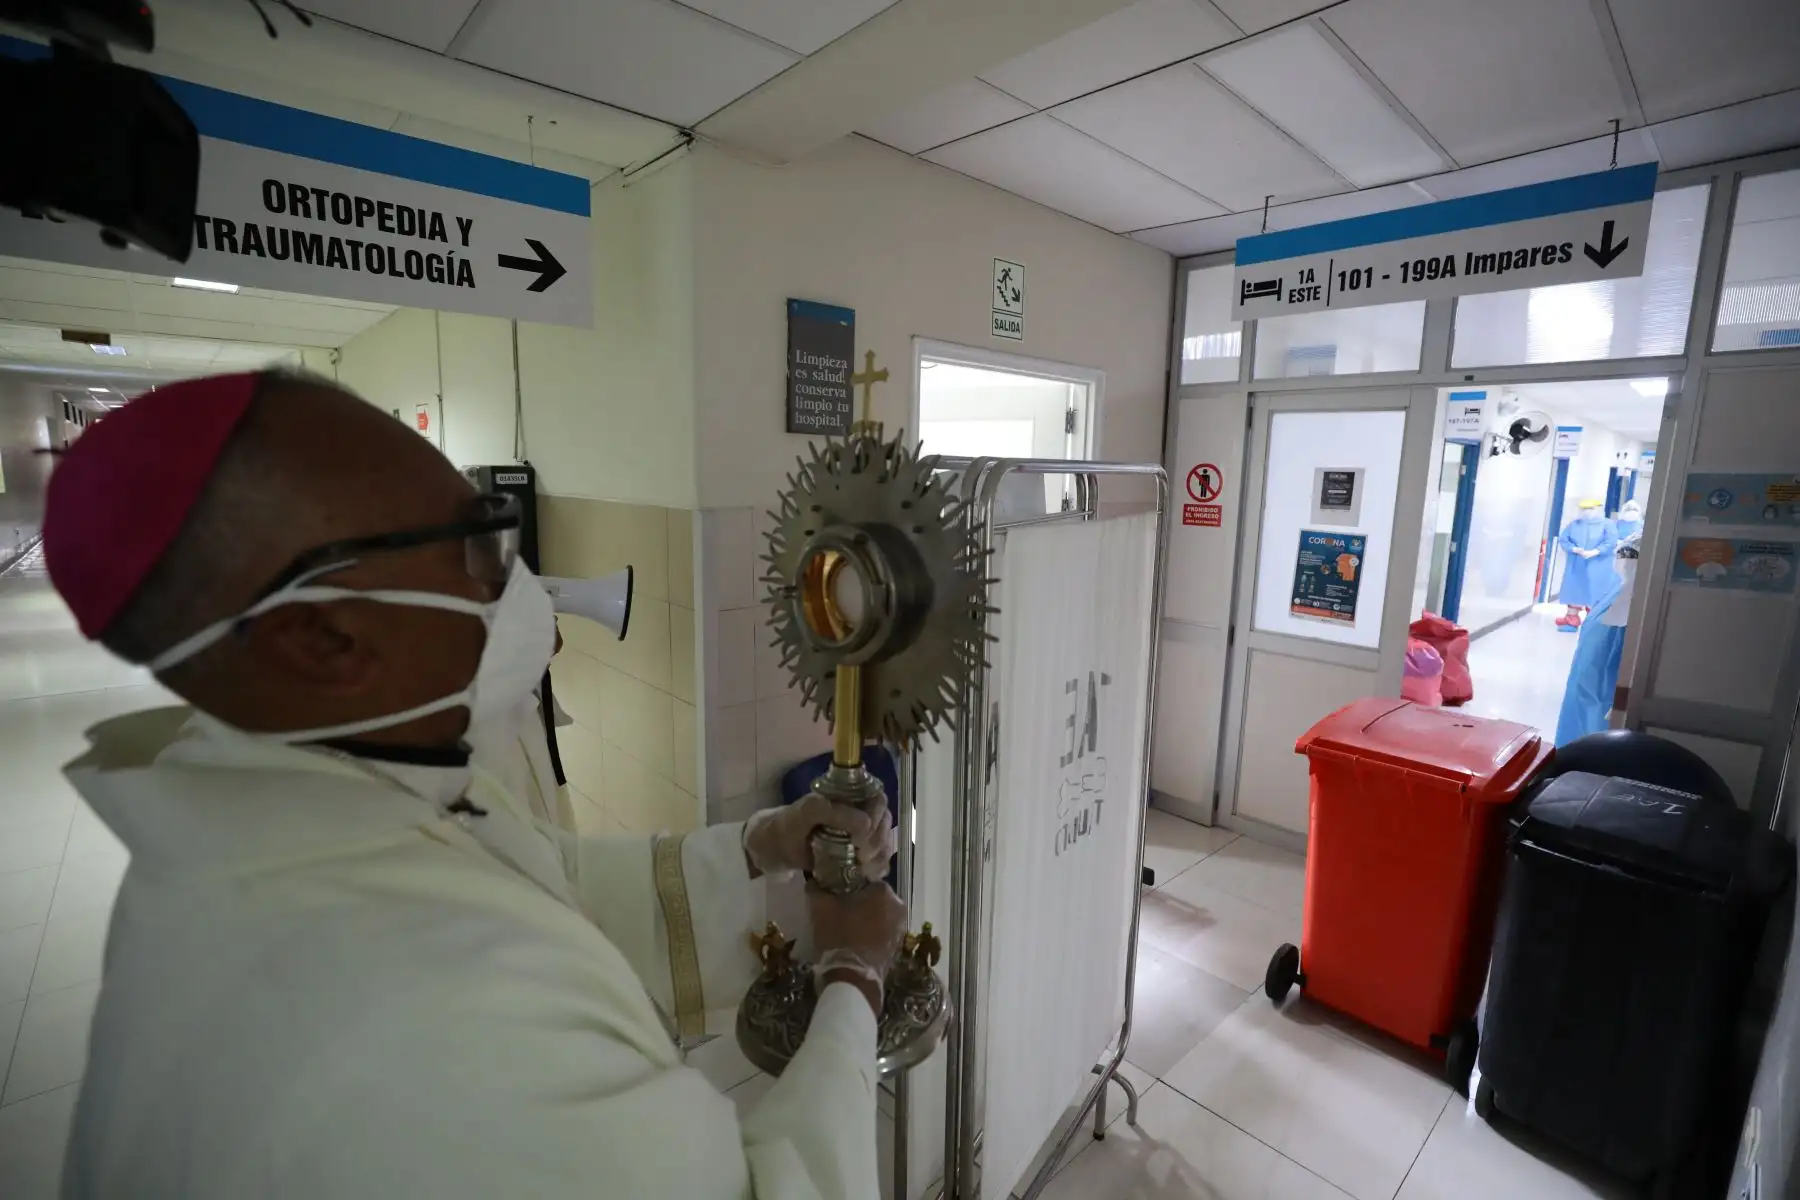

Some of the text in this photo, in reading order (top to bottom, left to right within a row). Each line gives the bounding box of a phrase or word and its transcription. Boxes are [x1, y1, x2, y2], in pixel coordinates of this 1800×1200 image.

[262, 178, 473, 247] ORTOPEDIA Y
[194, 213, 476, 289] TRAUMATOLOGÍA
[1338, 266, 1373, 292] 101
[1400, 258, 1457, 284] 199A
[1465, 241, 1574, 275] Impares
[1298, 268, 1315, 284] 1A
[1288, 286, 1321, 305] ESTE
[994, 318, 1020, 333] SALIDA
[795, 350, 848, 369] Limpieza
[795, 368, 807, 378] es
[795, 383, 846, 398] conserva
[795, 396, 849, 414] limpio tu
[795, 411, 844, 429] hospital.
